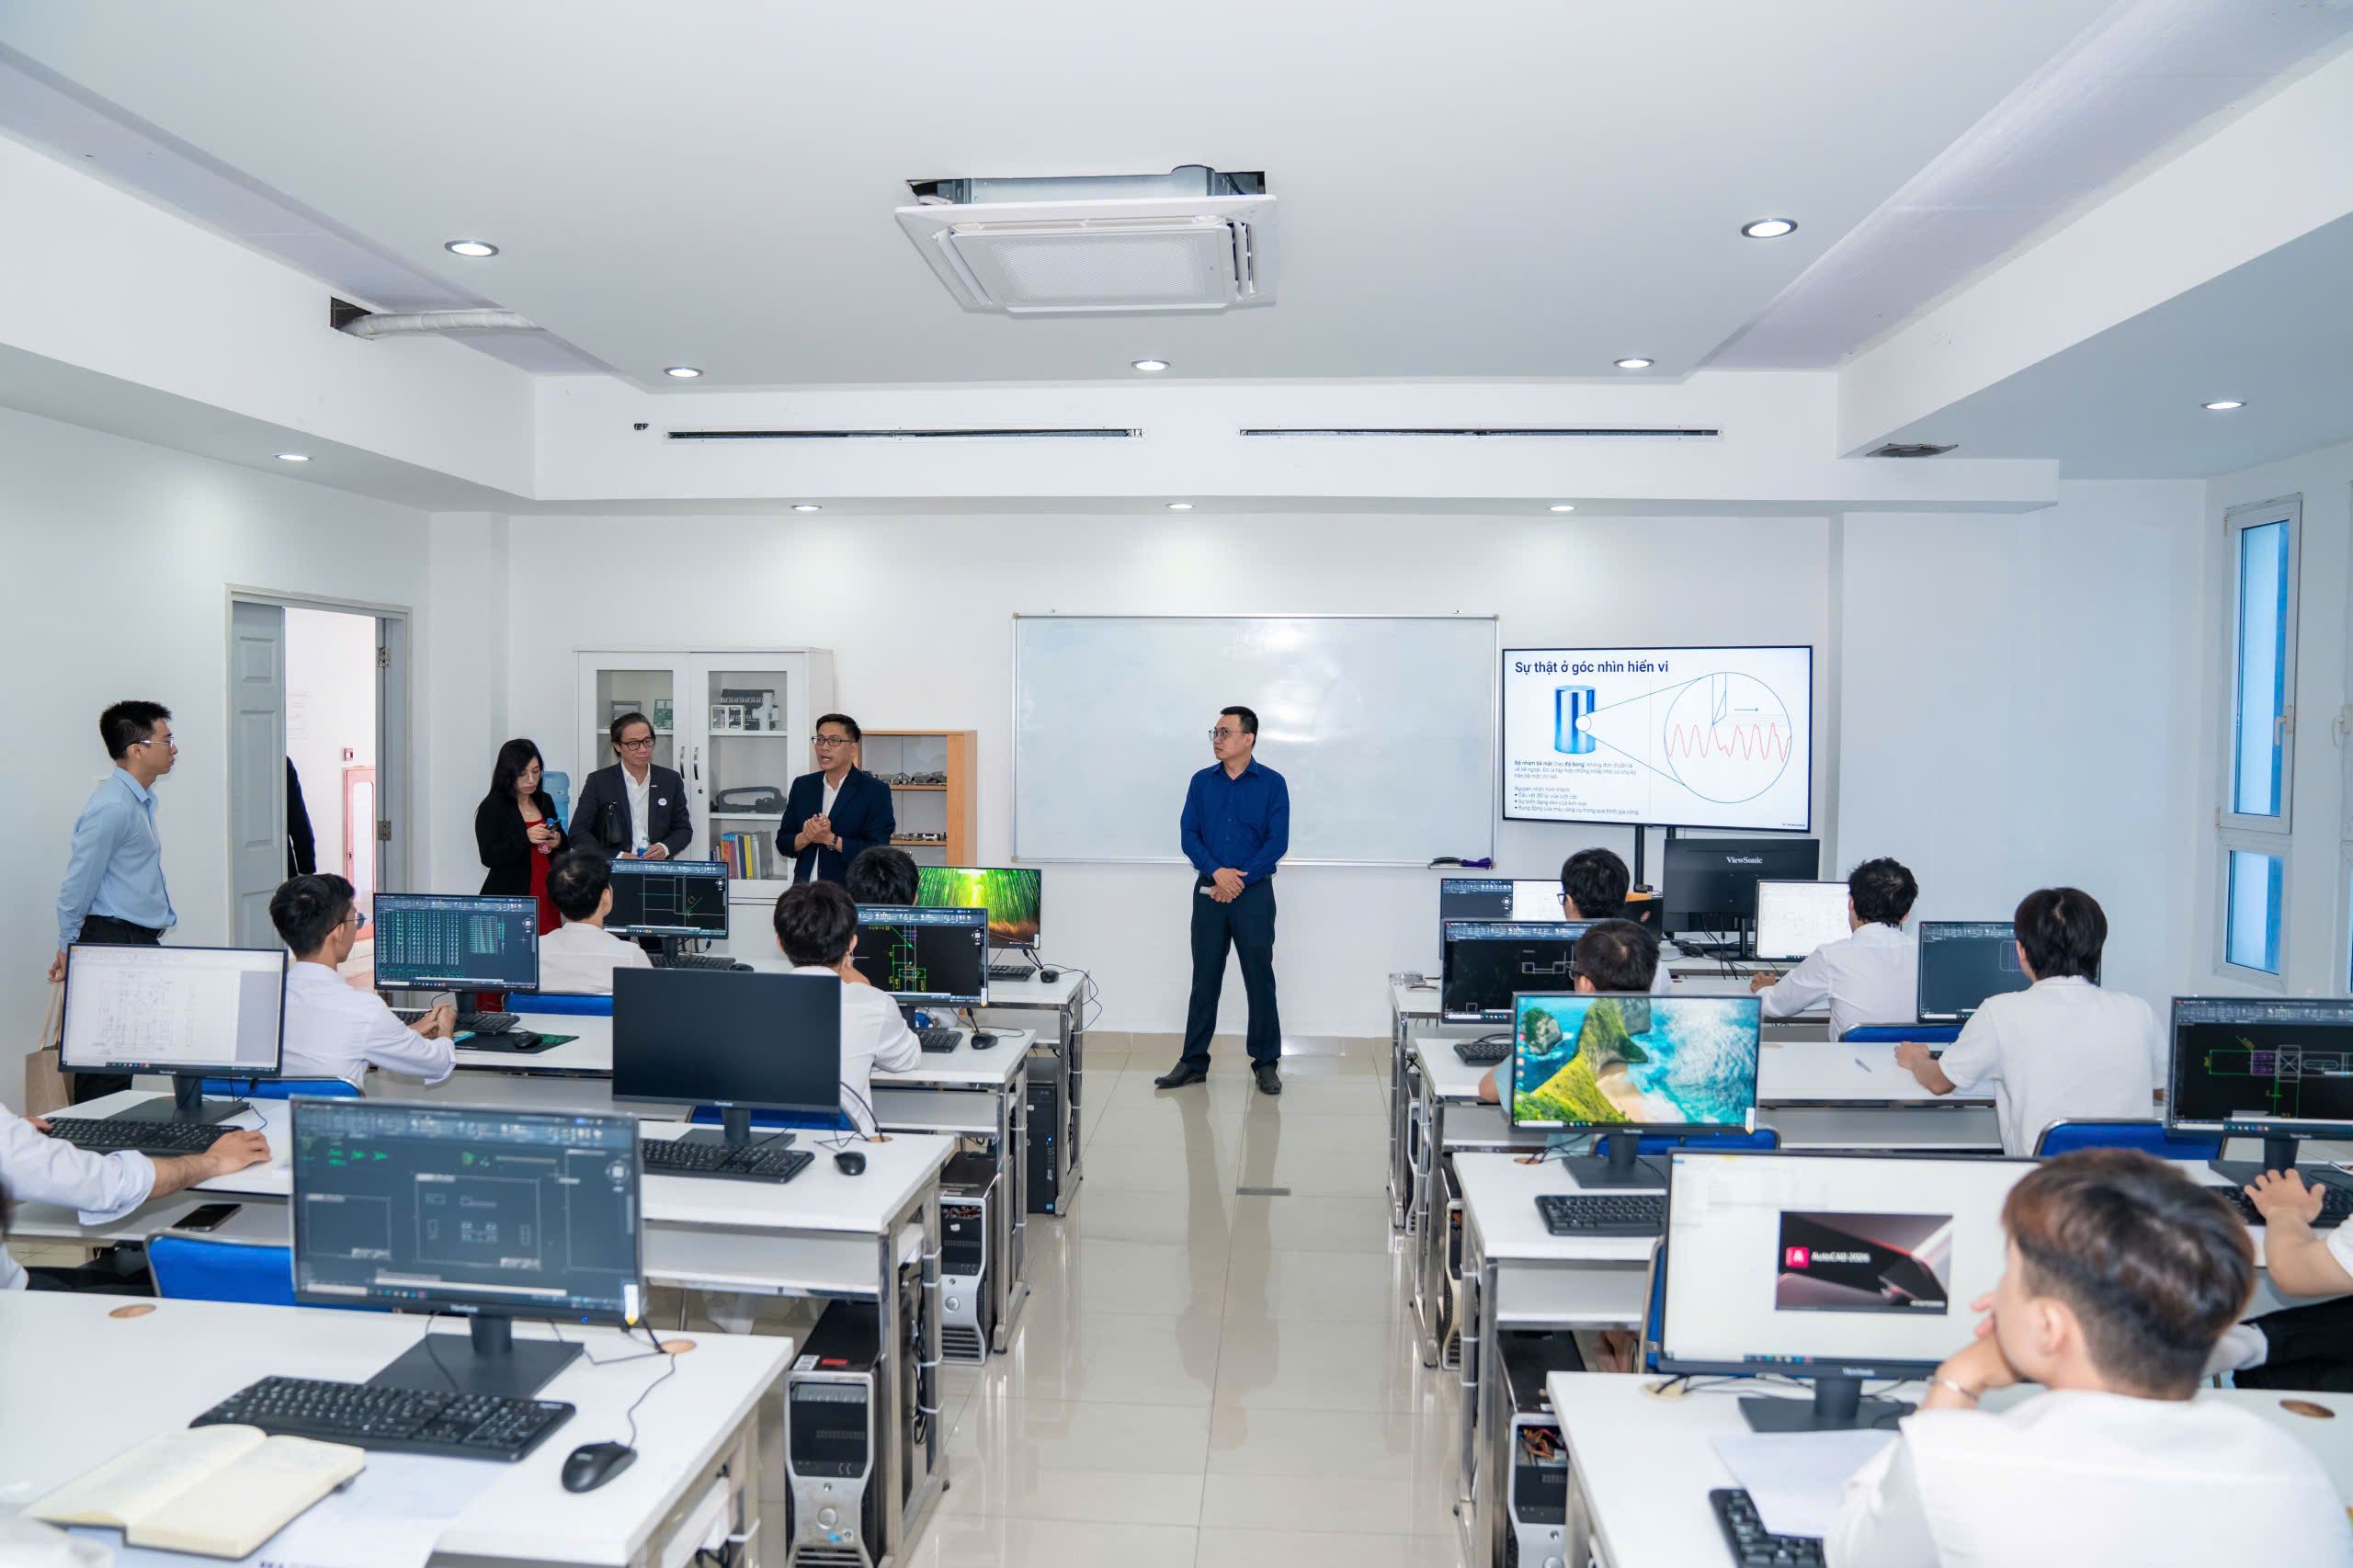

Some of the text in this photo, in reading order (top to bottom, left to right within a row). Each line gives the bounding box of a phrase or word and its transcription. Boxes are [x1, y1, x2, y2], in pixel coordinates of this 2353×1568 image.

[1516, 660, 1668, 675] Sự thật ở góc nhìn hiển vi
[1726, 856, 1764, 864] ViewSonic
[1811, 1250, 1847, 1263] AutoCAD
